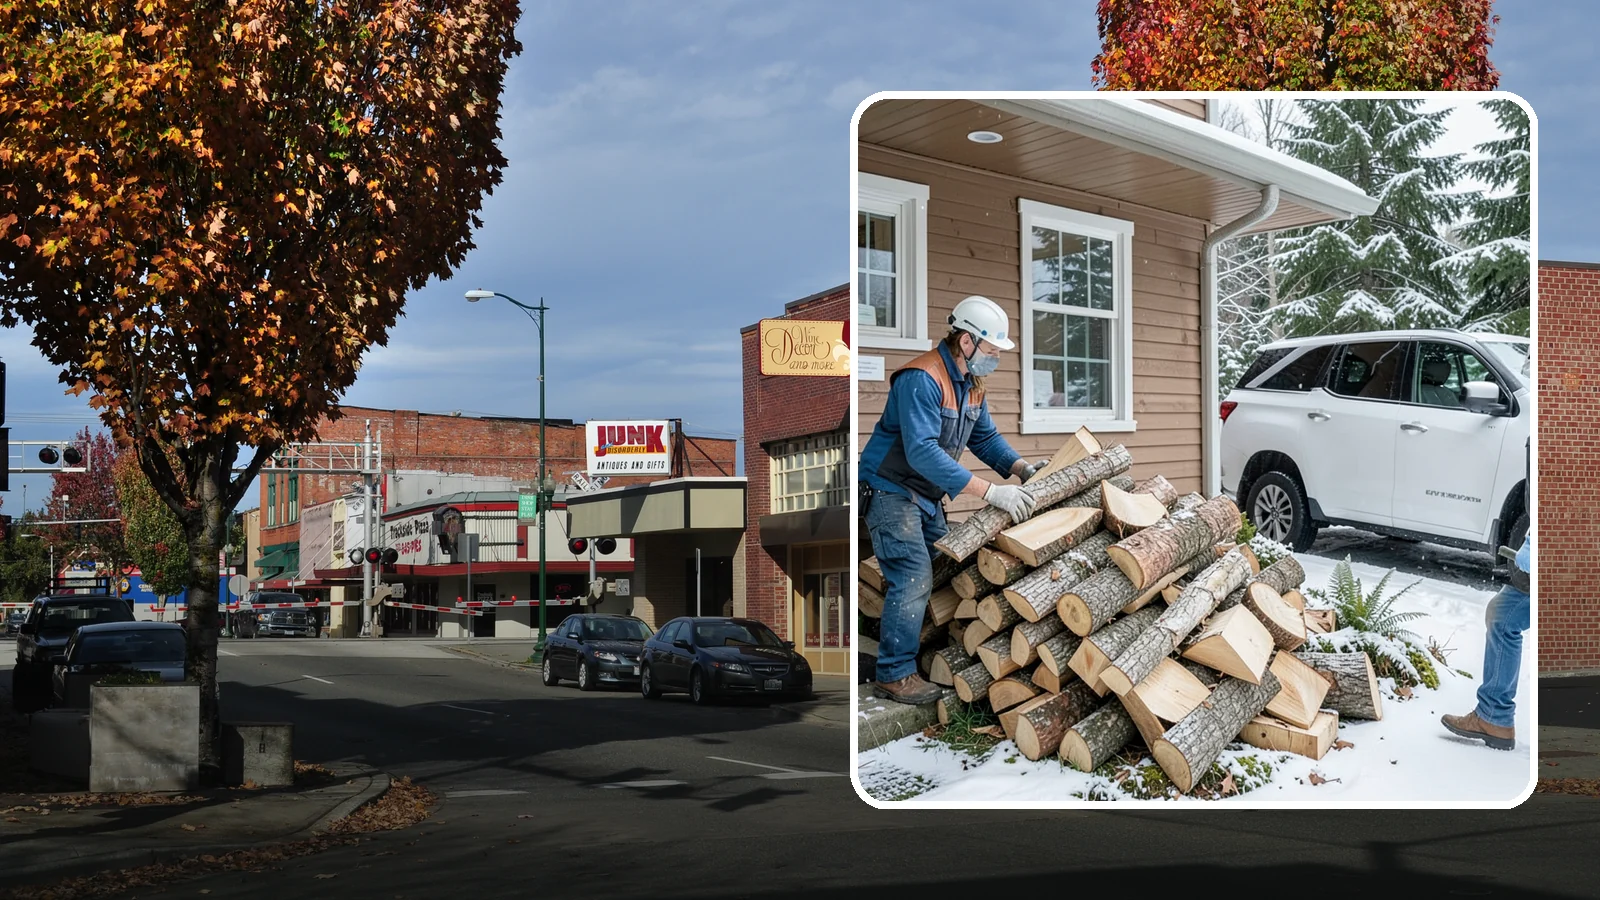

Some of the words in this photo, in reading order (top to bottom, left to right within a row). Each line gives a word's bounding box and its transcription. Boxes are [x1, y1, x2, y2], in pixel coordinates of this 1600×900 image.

[595, 425, 665, 457] JUNK
[607, 446, 645, 454] DISORDERLY
[597, 461, 628, 470] ANTIQUES
[631, 461, 643, 469] AND
[647, 461, 665, 469] GIFTS
[573, 473, 589, 492] RAIL
[390, 521, 413, 539] Trackside
[414, 519, 429, 534] Pizza
